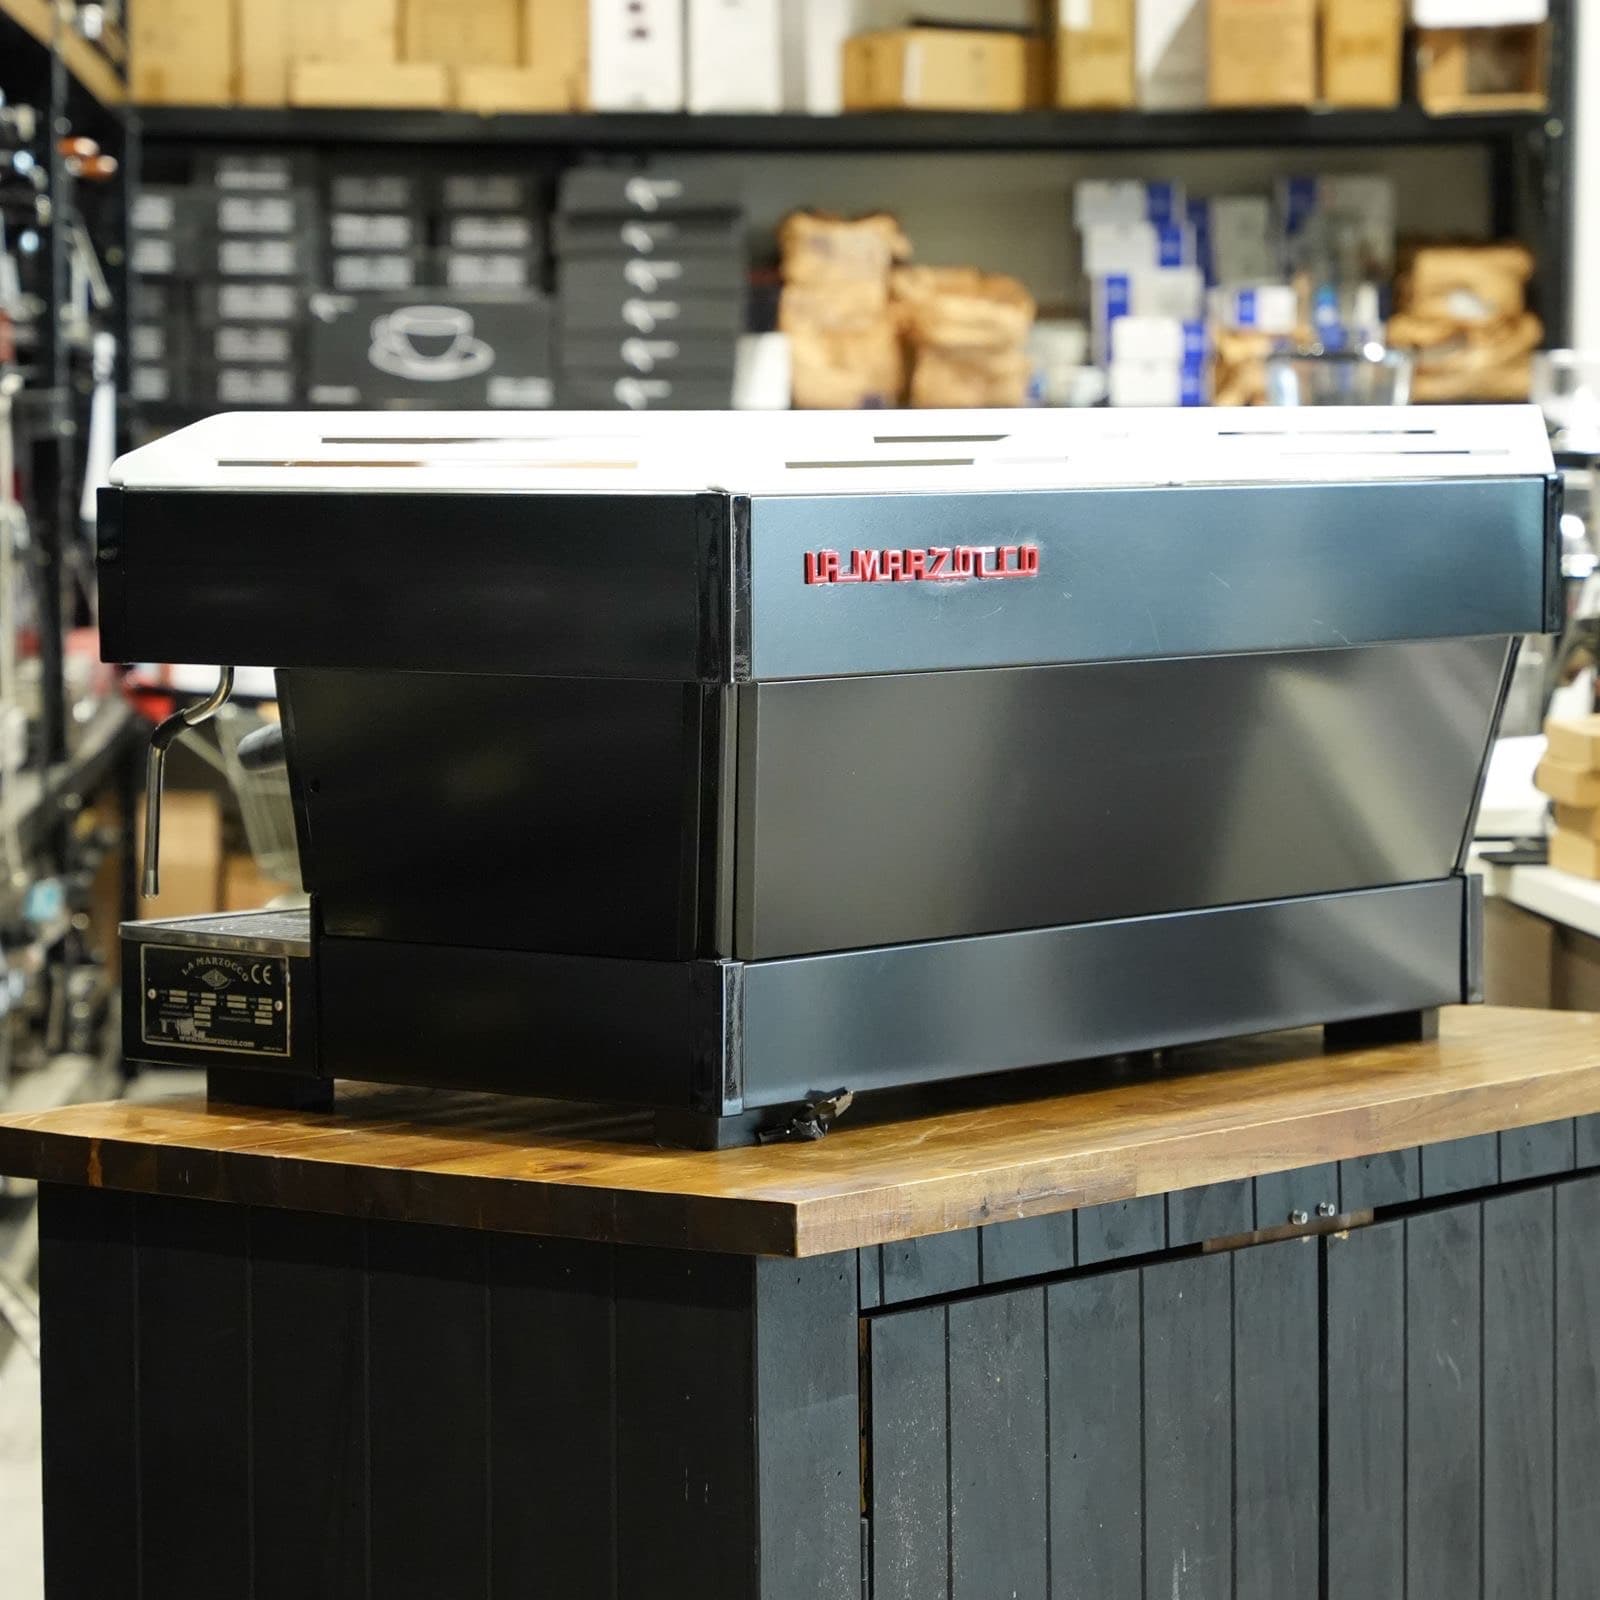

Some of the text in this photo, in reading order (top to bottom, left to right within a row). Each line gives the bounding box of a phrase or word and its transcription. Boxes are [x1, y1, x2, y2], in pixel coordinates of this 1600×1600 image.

[804, 548, 839, 585] LA
[182, 956, 249, 983] LA MARZOCCO
[250, 963, 273, 985] CE
